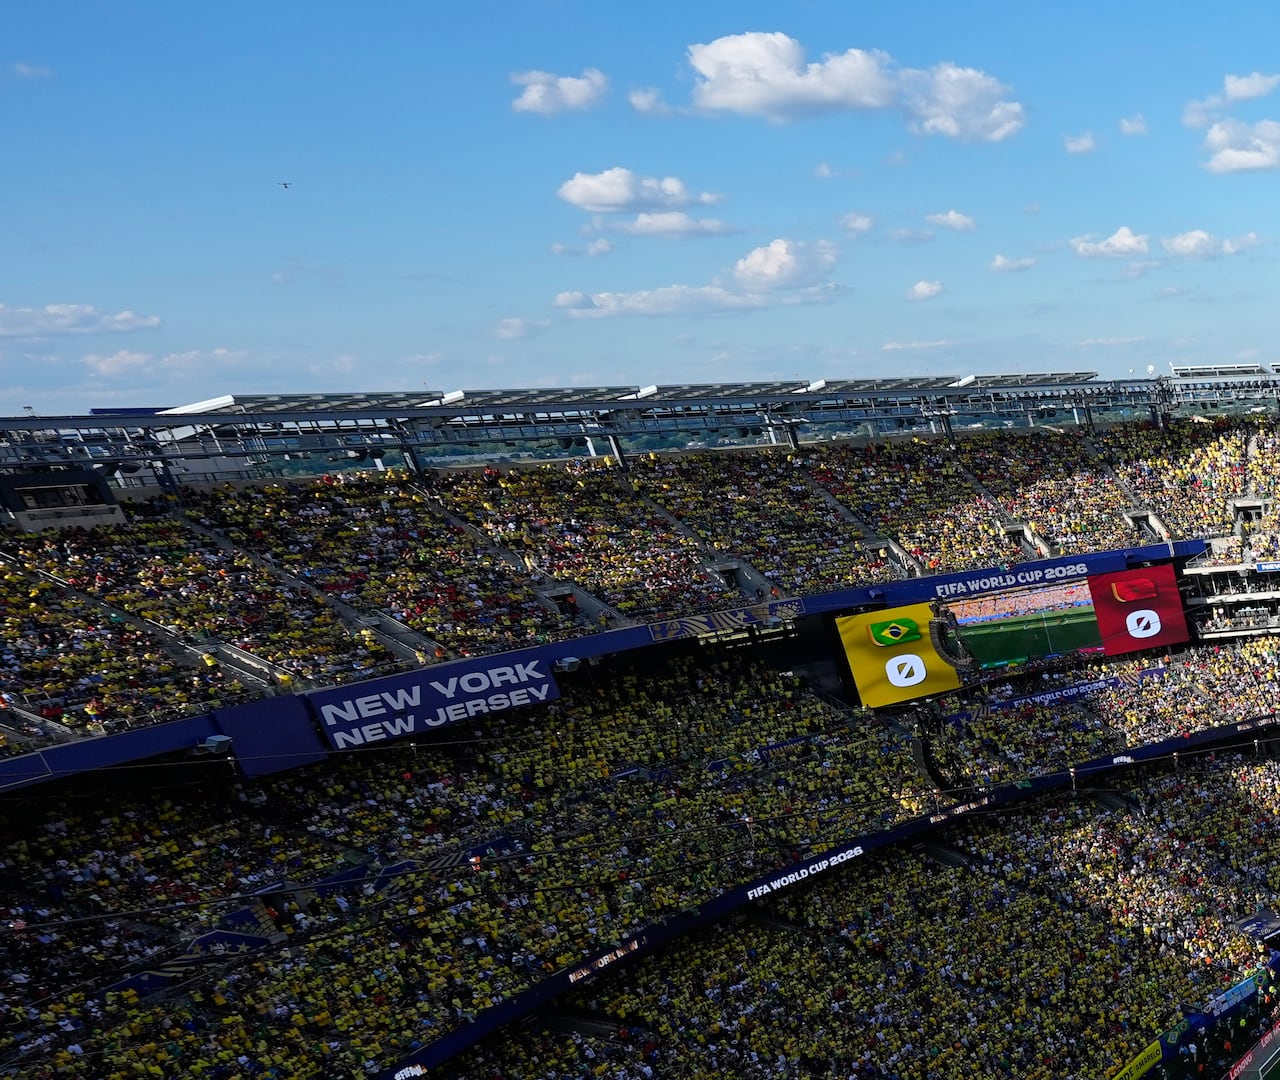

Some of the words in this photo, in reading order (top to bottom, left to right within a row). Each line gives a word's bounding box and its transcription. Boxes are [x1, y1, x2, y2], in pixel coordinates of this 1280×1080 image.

[936, 584, 966, 597] FIFA
[966, 574, 1015, 593] WORLD
[1017, 570, 1043, 584] CUP
[1045, 564, 1088, 579] 2026
[1126, 609, 1161, 638] 0
[885, 653, 927, 688] 0
[321, 686, 421, 726] NEW
[429, 660, 547, 699] YORK
[1062, 686, 1079, 697] CUP
[1079, 681, 1107, 693] 2026
[332, 715, 416, 749] NEW
[424, 683, 550, 727] JERSEY
[747, 884, 772, 900] FIFA
[770, 868, 809, 891] WORLD
[808, 860, 829, 875] CUP
[829, 846, 864, 867] 2026
